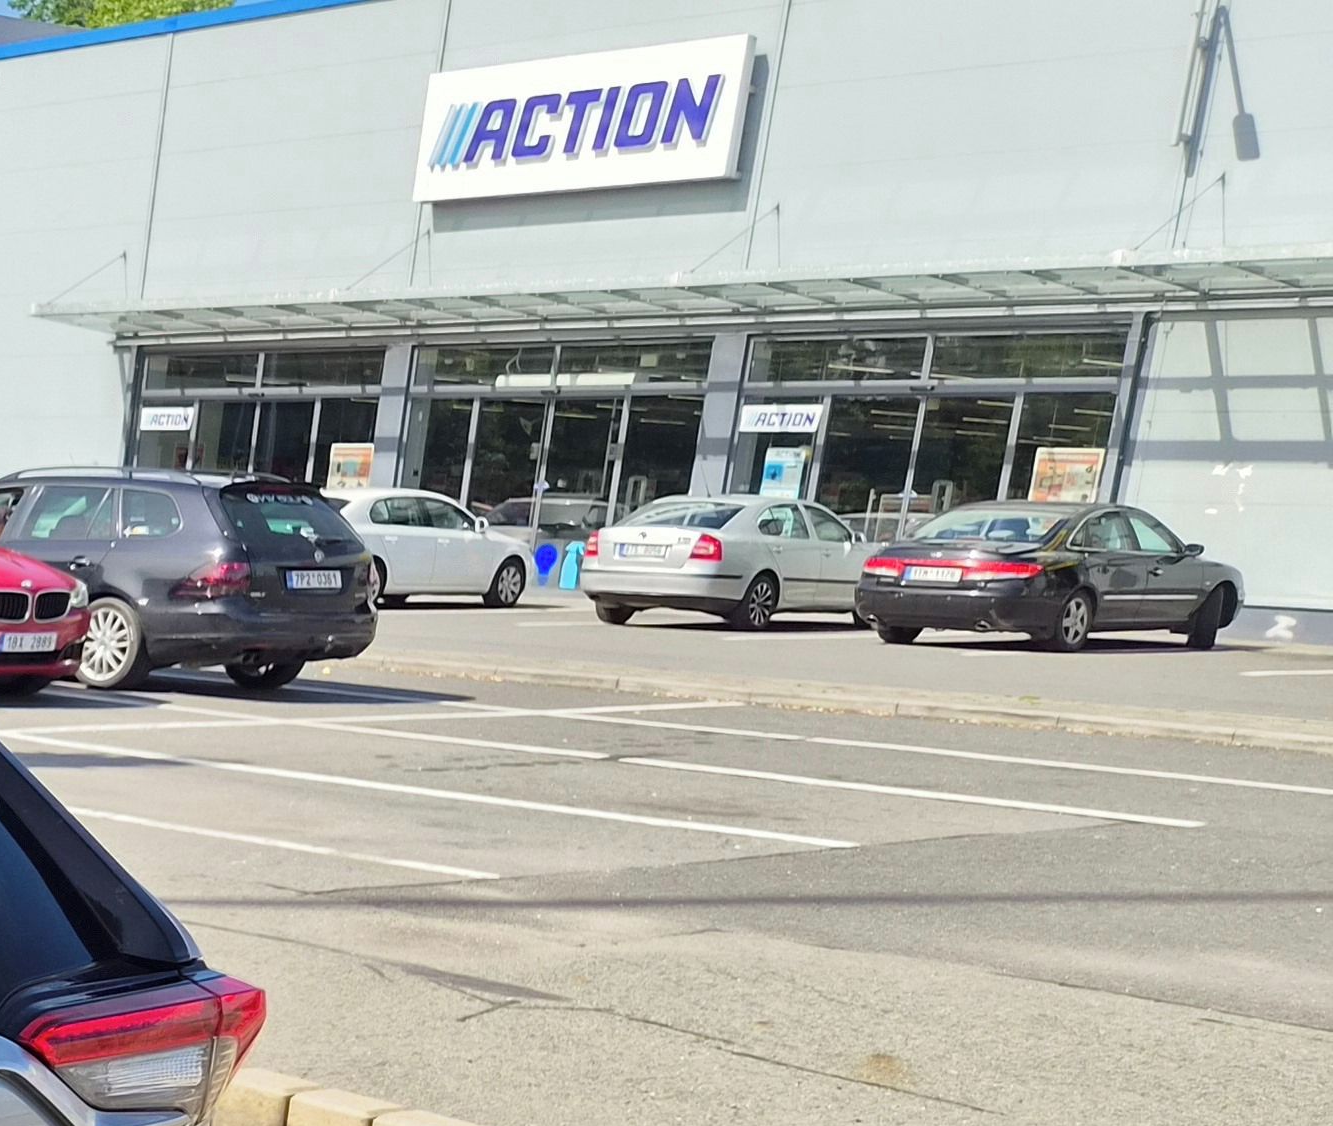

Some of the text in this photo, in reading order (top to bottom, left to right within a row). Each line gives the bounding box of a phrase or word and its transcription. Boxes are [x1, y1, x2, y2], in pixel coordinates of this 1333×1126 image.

[463, 74, 725, 165] ACTION
[150, 413, 190, 426] ACTION
[754, 412, 816, 427] ACTION
